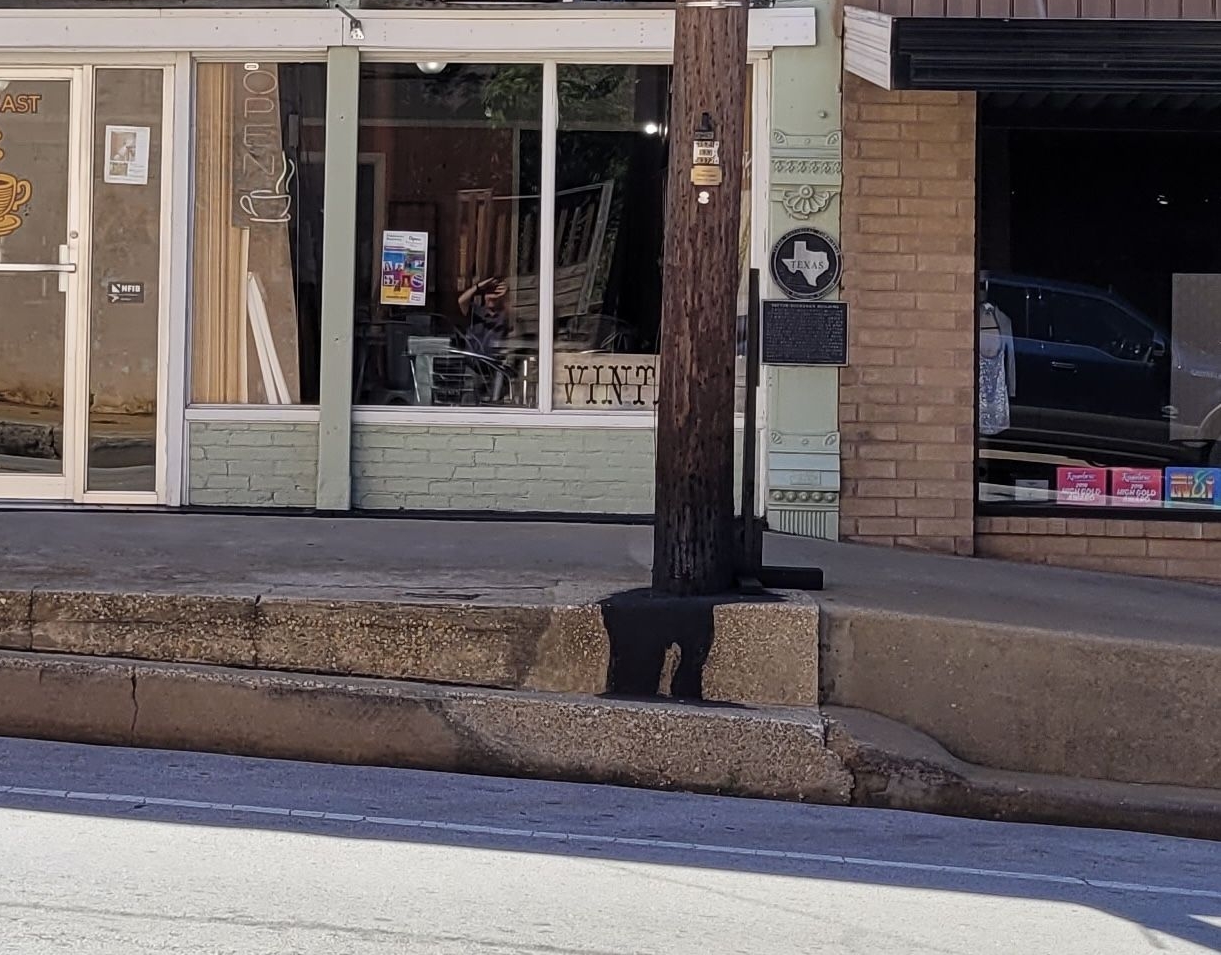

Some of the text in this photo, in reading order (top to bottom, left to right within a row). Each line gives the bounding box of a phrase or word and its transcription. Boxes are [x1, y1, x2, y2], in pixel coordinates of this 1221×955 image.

[242, 70, 278, 176] OPEN
[791, 260, 824, 270] TEXAS
[563, 364, 659, 405] VINT
[1081, 487, 1101, 496] GOLD
[1136, 489, 1157, 497] GOLD
